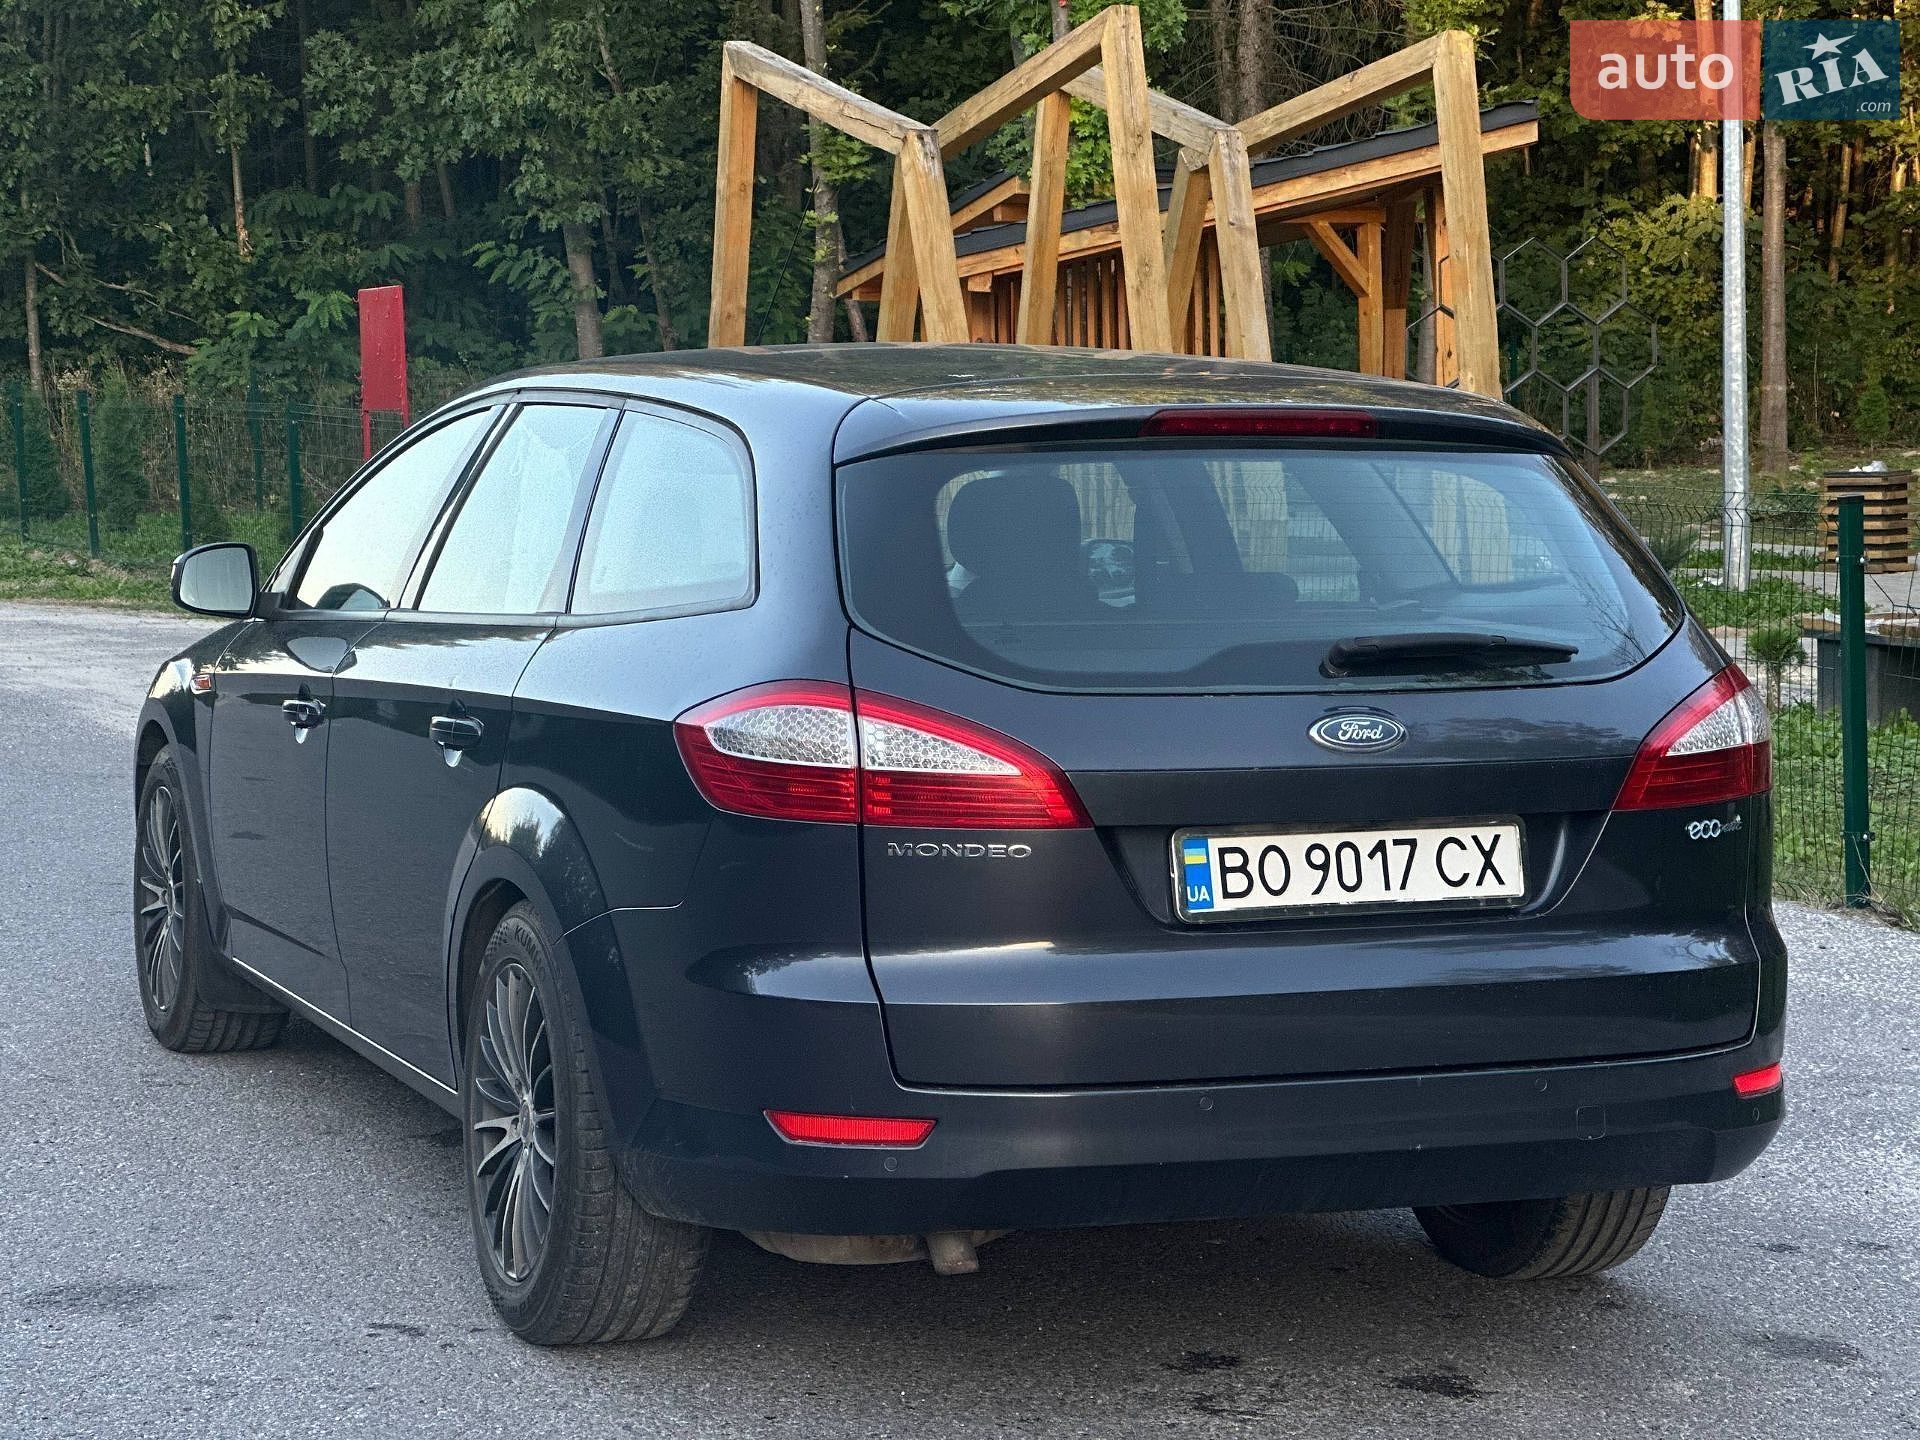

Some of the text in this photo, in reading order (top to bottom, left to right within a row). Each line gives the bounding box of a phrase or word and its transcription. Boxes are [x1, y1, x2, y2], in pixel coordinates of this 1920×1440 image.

[1337, 720, 1384, 741] Ford
[887, 842, 1032, 858] MONDEO
[1217, 833, 1506, 900] BO 9017 CX
[1186, 886, 1211, 903] UA
